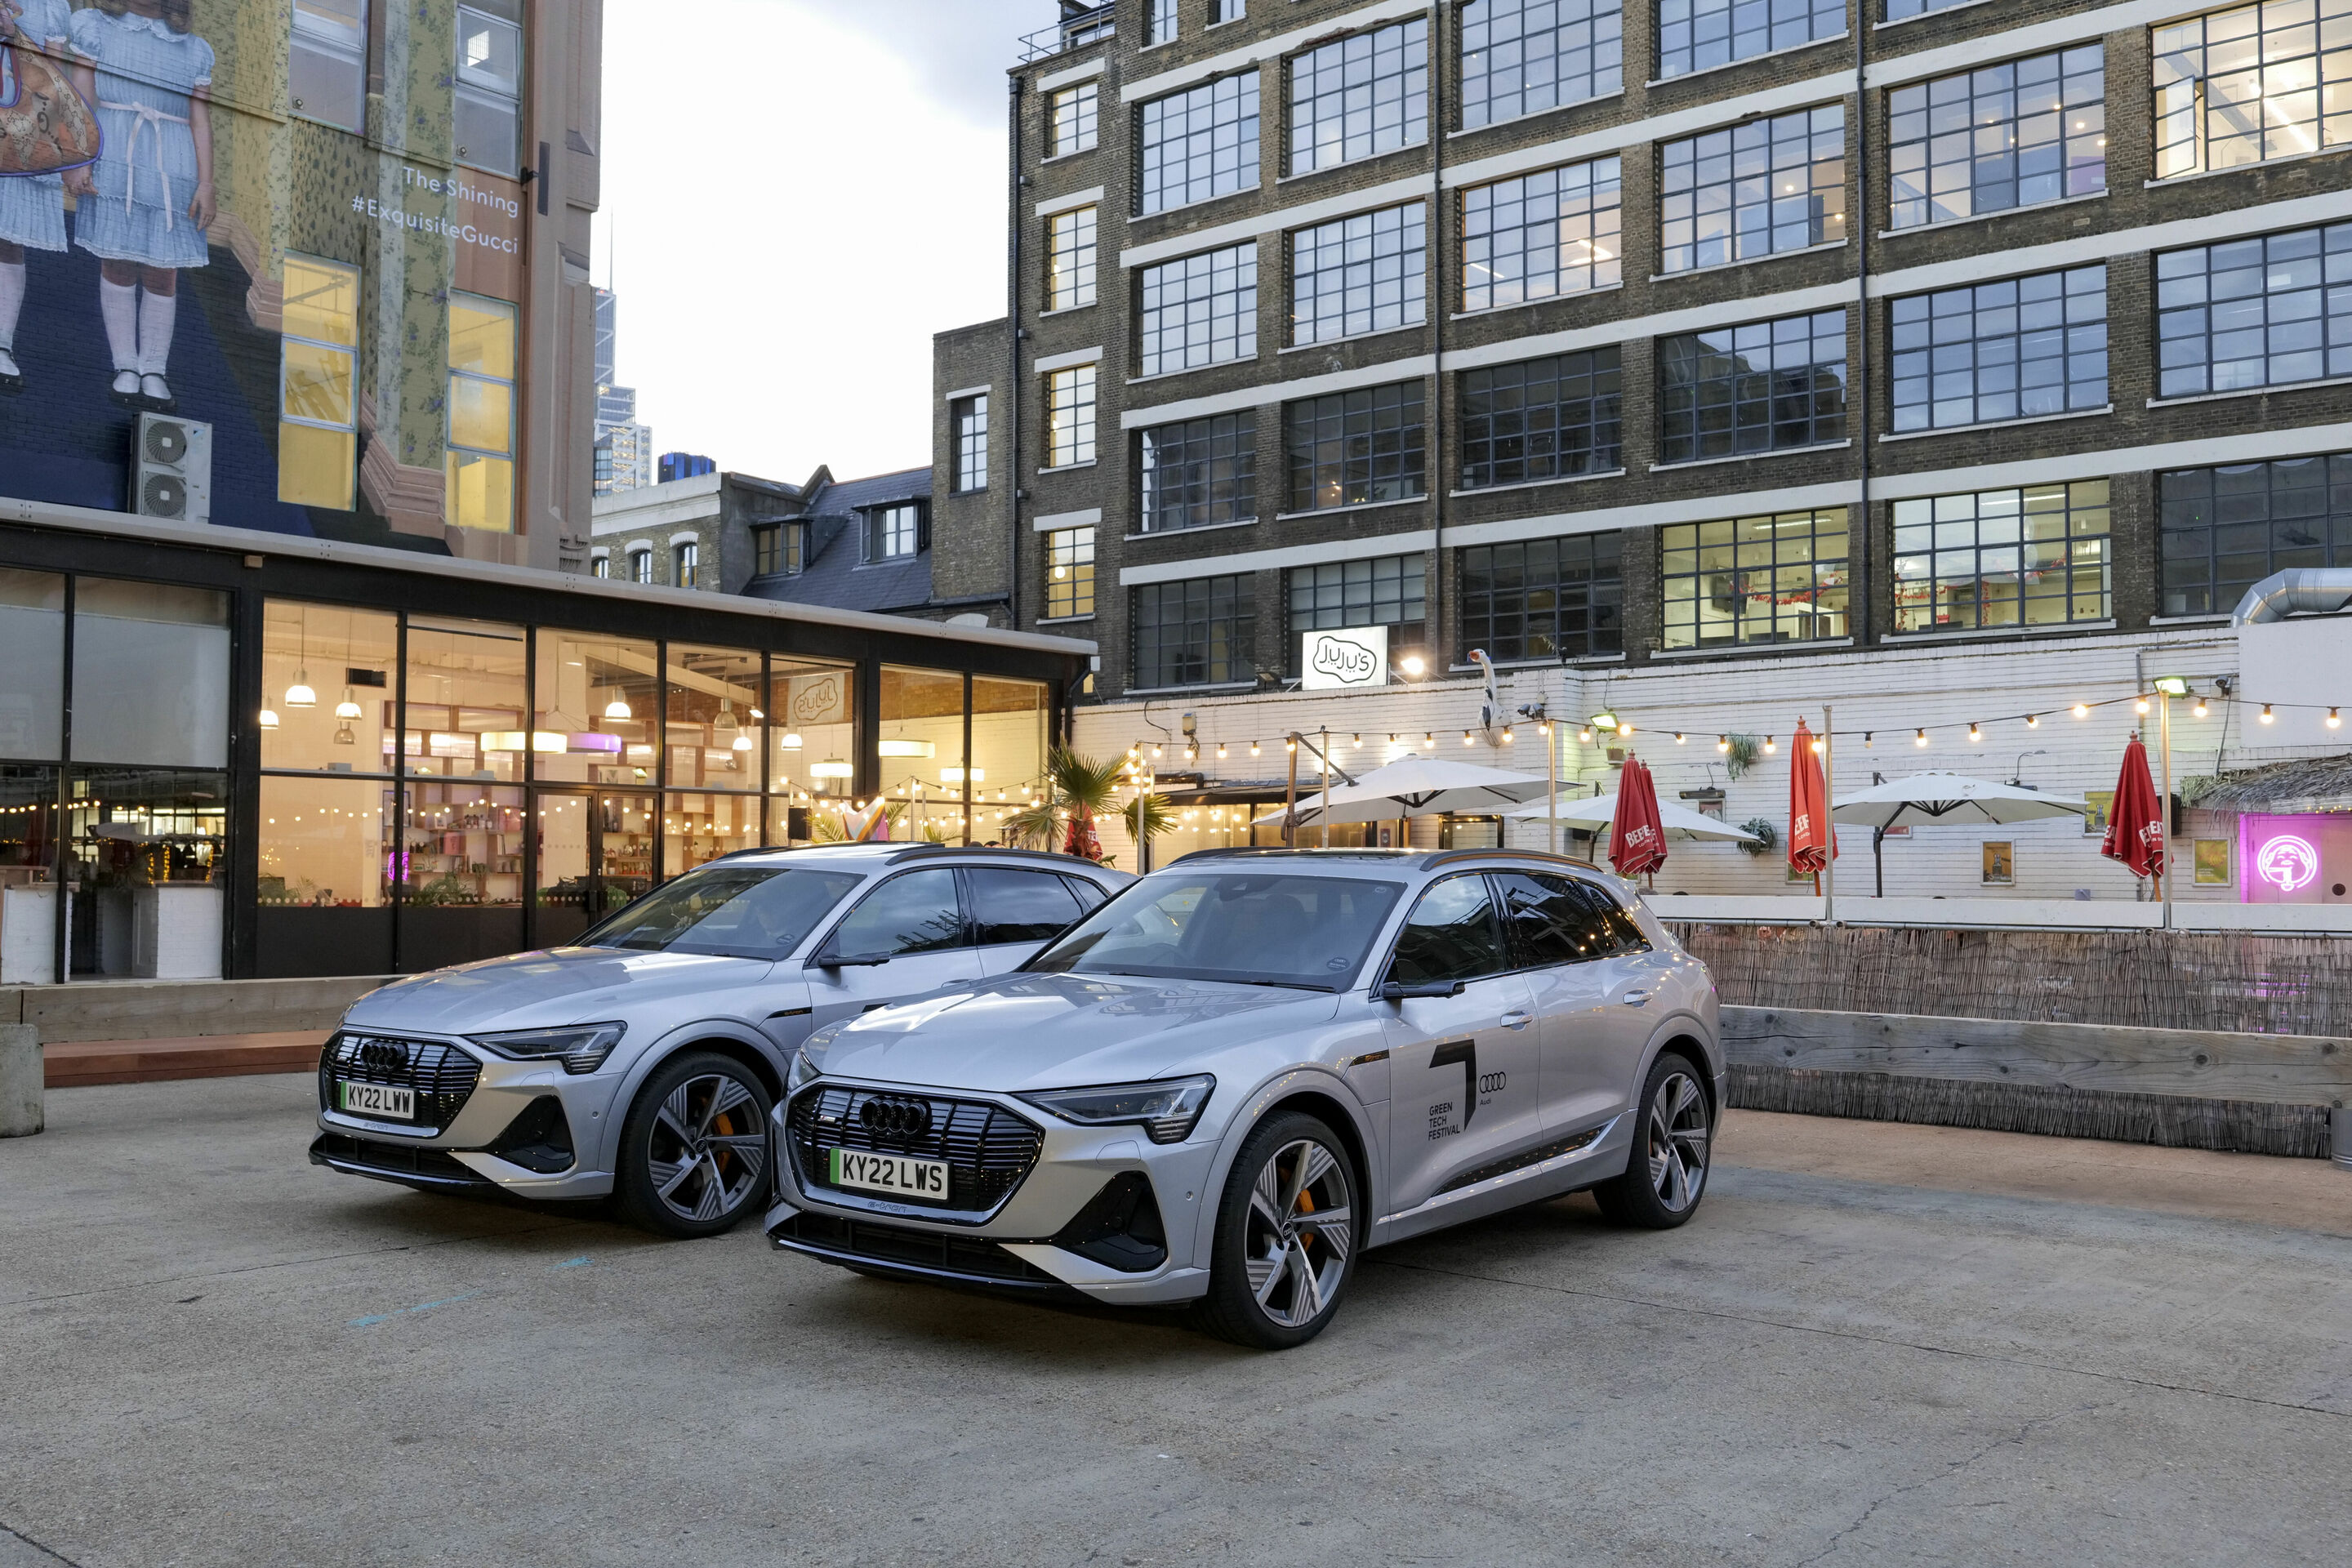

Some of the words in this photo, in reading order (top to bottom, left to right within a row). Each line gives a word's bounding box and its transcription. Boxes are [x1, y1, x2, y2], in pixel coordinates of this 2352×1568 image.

[403, 166, 441, 193] The
[446, 179, 519, 219] Shining
[351, 195, 519, 255] #ExquisiteGucci
[349, 1085, 381, 1110] KY22
[384, 1089, 411, 1113] LWW
[1479, 1098, 1492, 1106] Audi
[1429, 1102, 1453, 1116] GREEN
[1428, 1115, 1447, 1129] TECH
[1428, 1124, 1460, 1141] FESTIVAL
[843, 1153, 894, 1187] KY22
[900, 1161, 942, 1192] LWS
[867, 1200, 908, 1214] e-tron
